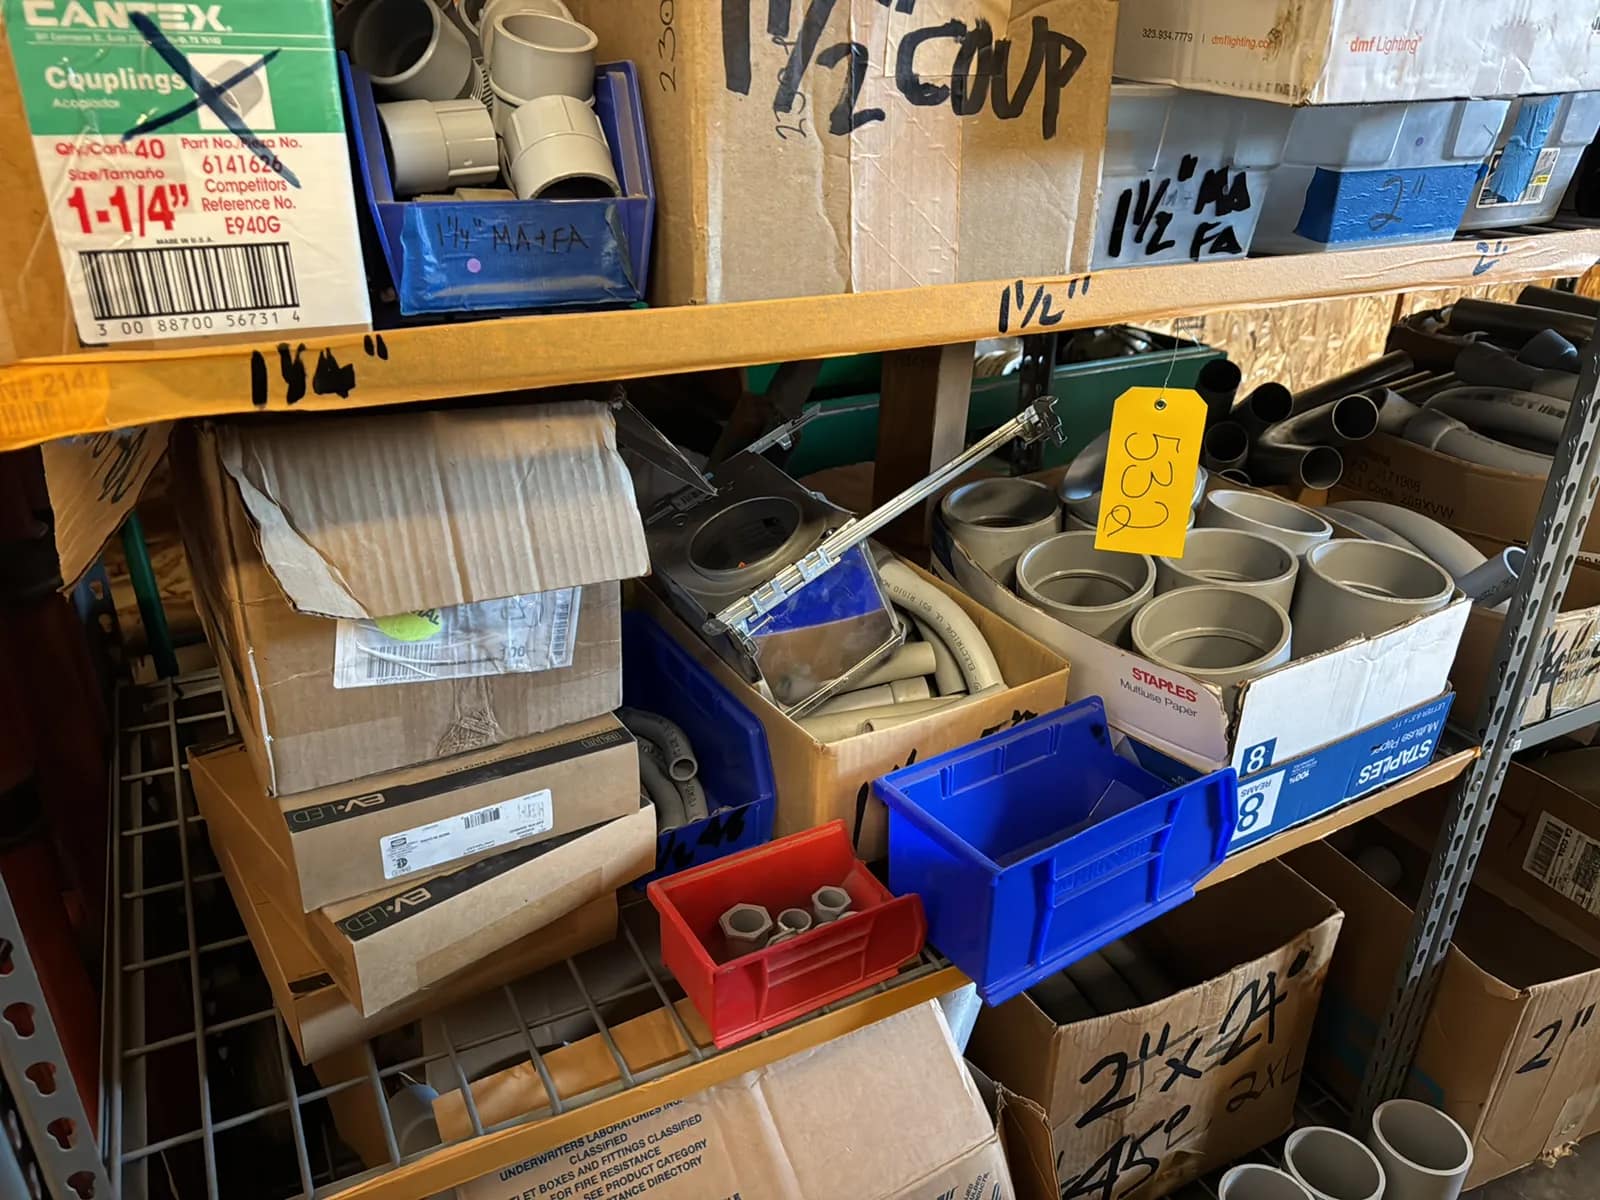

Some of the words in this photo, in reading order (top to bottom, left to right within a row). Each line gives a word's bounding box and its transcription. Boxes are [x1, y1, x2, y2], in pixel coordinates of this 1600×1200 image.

[1142, 28, 1194, 43] 323.934.7779
[1350, 36, 1376, 53] dmf
[45, 66, 187, 96] Couplings
[134, 139, 166, 160] 40
[181, 137, 209, 149] Part
[279, 137, 303, 149] No.
[202, 154, 284, 175] 6141626
[204, 176, 288, 196] Competitors
[201, 195, 271, 213] Reference
[274, 195, 297, 211] No.
[225, 215, 281, 236] E940G
[98, 323, 108, 338] 3
[121, 320, 145, 336] 00
[158, 315, 214, 333] 88700
[226, 311, 280, 328] 56731
[292, 308, 302, 323] 4
[1103, 430, 1182, 539] 532
[1119, 678, 1162, 704] Multiuse
[1163, 697, 1198, 718] Paper
[1132, 667, 1197, 703] STAPLES
[1246, 744, 1267, 774] 8
[1358, 739, 1433, 786] STAPLES
[1240, 778, 1273, 798] REAMS
[1237, 791, 1265, 833] 8
[1514, 1001, 1597, 1075] 2"
[499, 1138, 586, 1182] UNDERWRITERS
[538, 1173, 576, 1195] BOXES
[577, 1160, 600, 1179] AND
[600, 1138, 647, 1166] FITTINGS
[646, 1113, 703, 1145] CLASSIFIED
[568, 1132, 629, 1166] CLASSIFIED
[549, 1187, 574, 1200] FOR
[574, 1174, 599, 1194] FIRE
[599, 1146, 662, 1181] RESISTANCE
[583, 1186, 604, 1200] SEE
[605, 1163, 657, 1194] PRODUCT
[656, 1137, 709, 1170] CATEGORY
[646, 1154, 703, 1188] DIRECTORY
